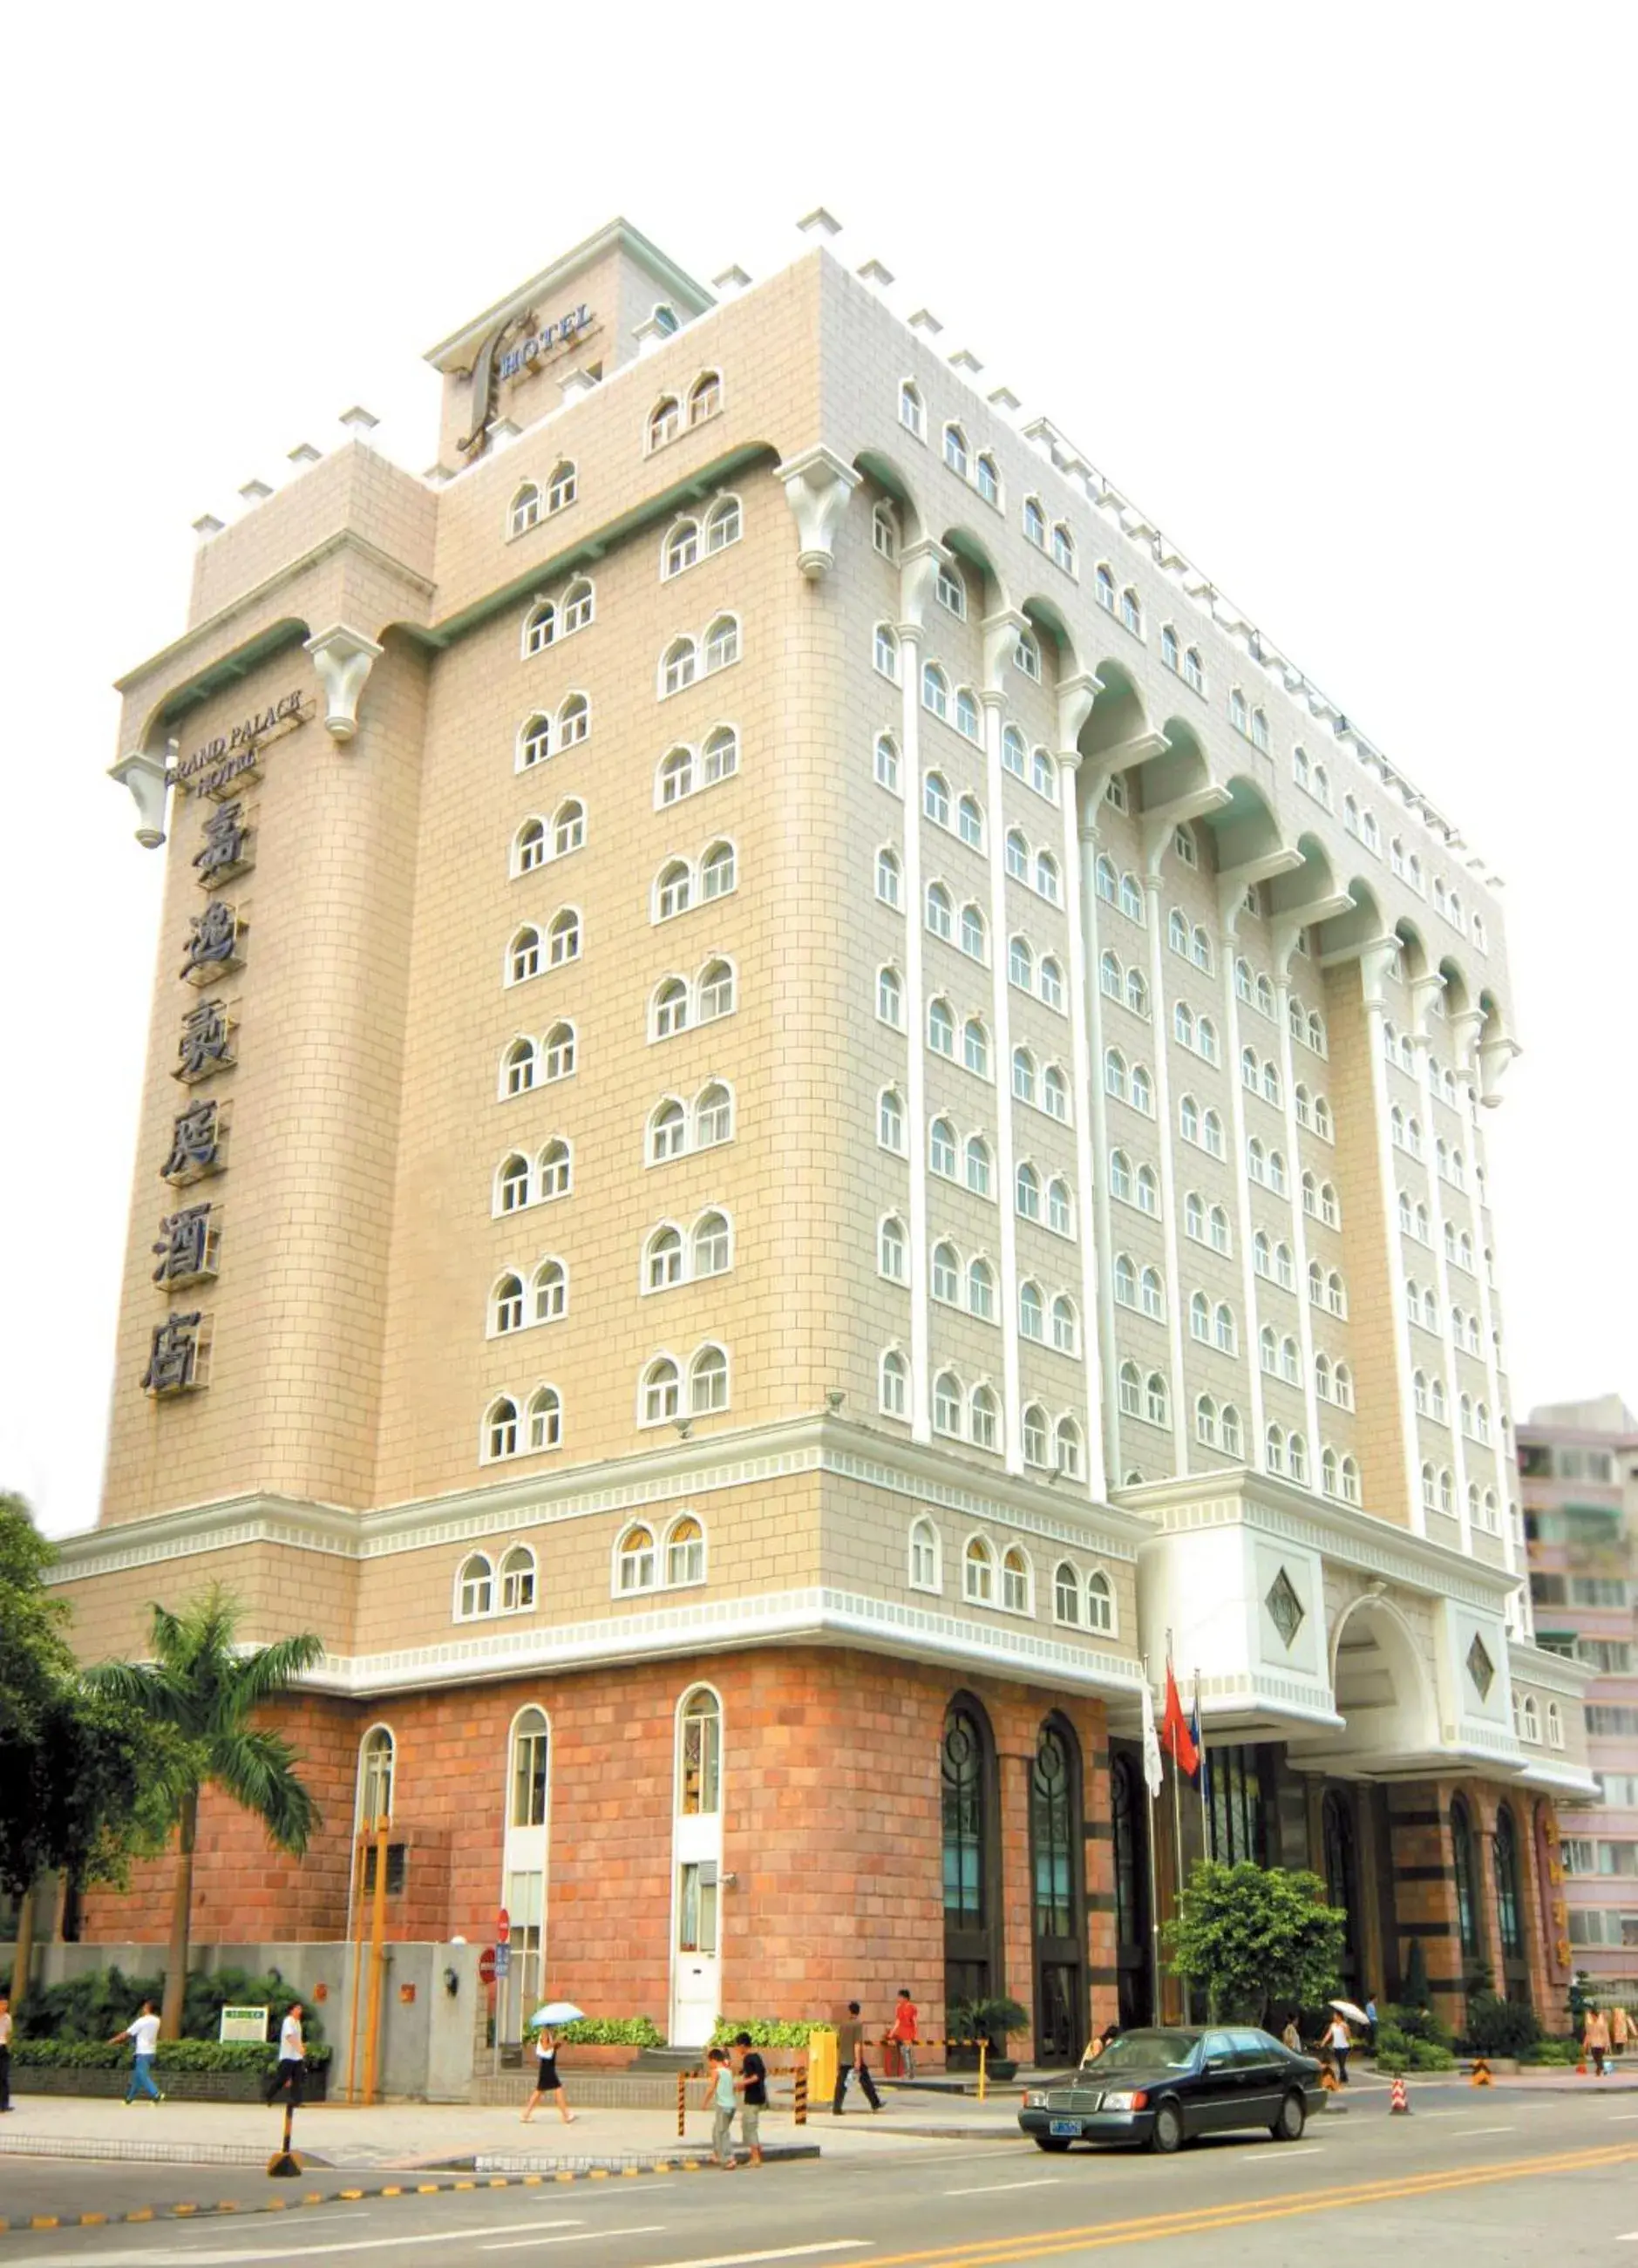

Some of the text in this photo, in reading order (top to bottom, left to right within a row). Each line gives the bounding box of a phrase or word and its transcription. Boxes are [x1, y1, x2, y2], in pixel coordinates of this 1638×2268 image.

[499, 303, 596, 381] HOTEL
[165, 689, 302, 786] GRAND PALACE
[196, 748, 256, 798] HOTEL
